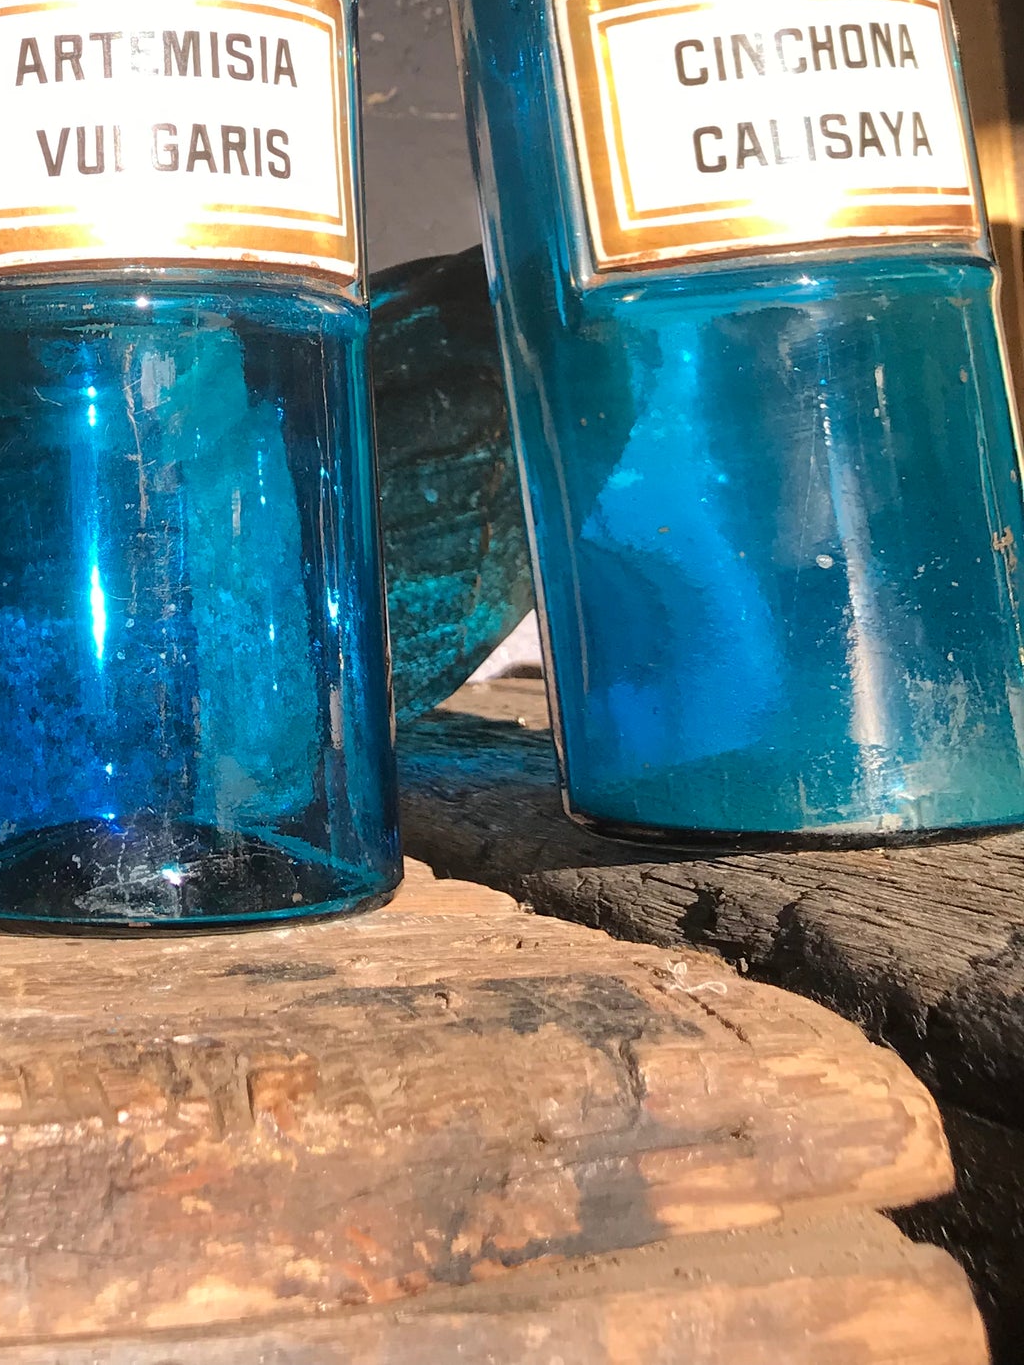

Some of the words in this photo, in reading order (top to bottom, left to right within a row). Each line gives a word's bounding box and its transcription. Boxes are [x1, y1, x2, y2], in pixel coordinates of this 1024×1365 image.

[15, 30, 298, 87] ARTEMISIA
[675, 22, 918, 86] CINCHONA
[693, 111, 933, 173] CALISAYA
